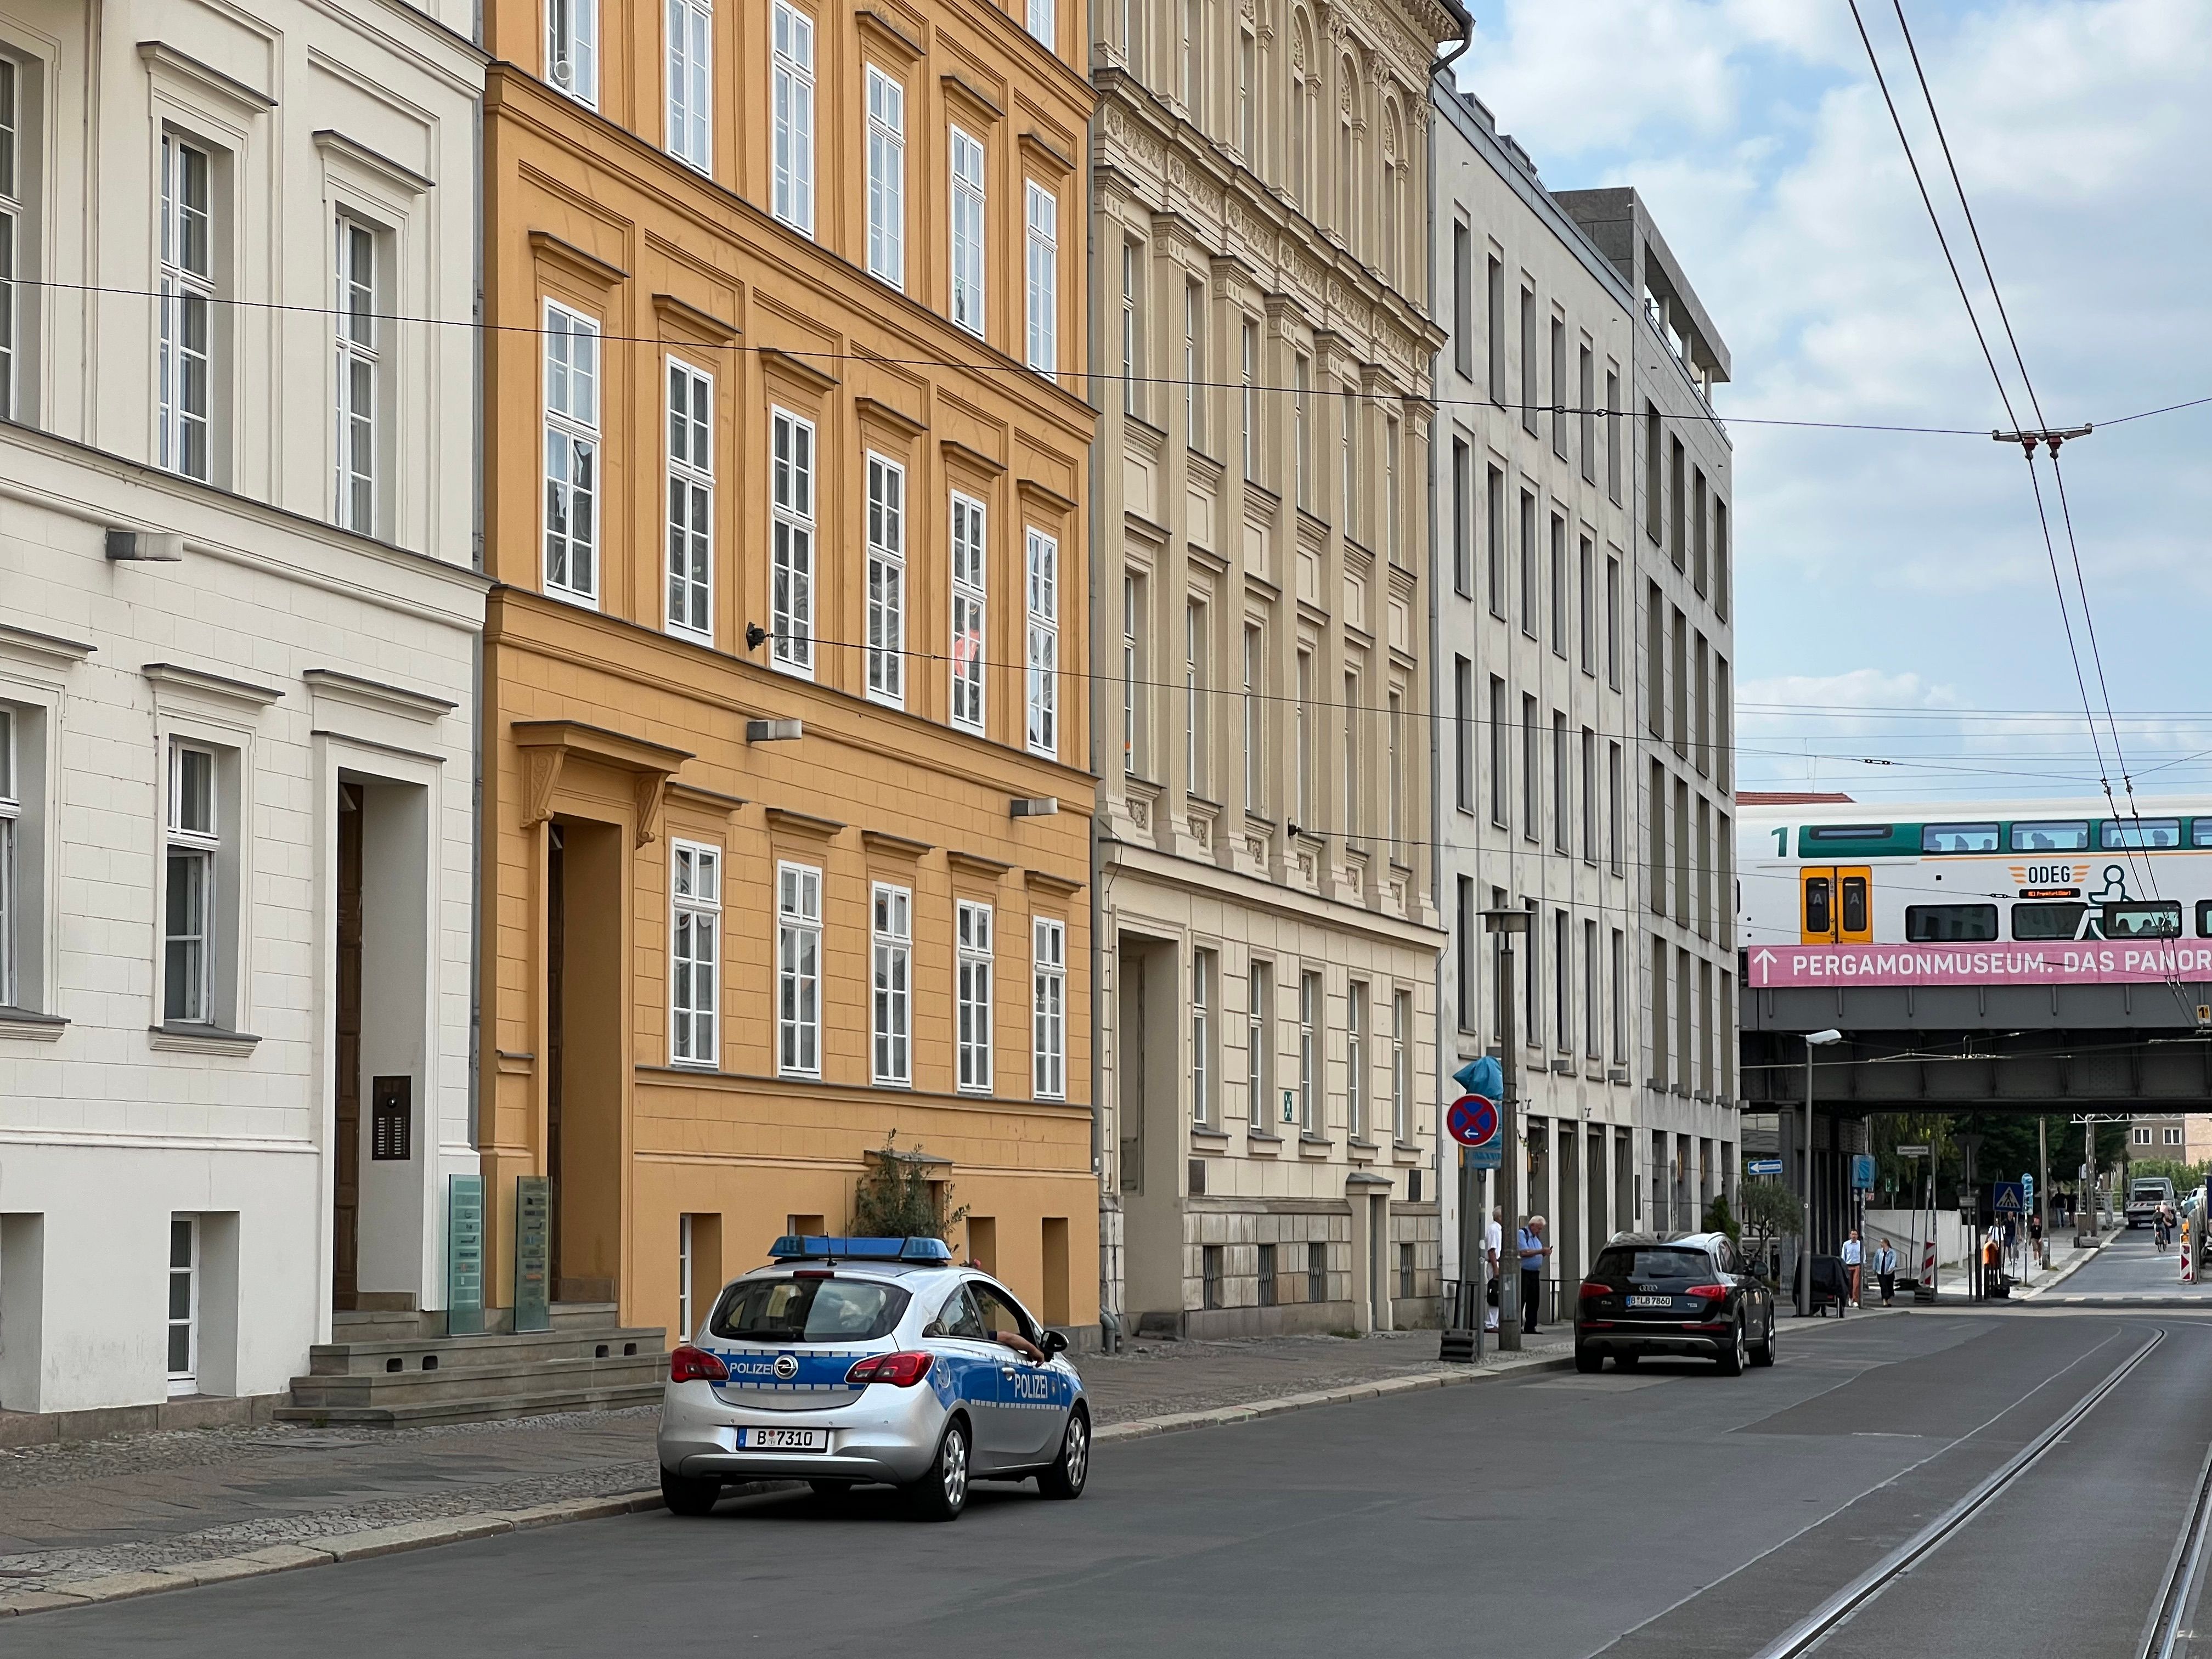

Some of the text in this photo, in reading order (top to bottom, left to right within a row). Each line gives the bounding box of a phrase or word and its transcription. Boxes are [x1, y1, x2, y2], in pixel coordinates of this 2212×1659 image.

[1771, 827, 1788, 857] 1
[2028, 865, 2070, 883] ODEG
[1792, 949, 2212, 976] PERGAMONMUSEUM. DAS PANOR
[729, 1362, 774, 1375] POLIZEI
[1014, 1373, 1048, 1399] POLIZEI
[757, 1430, 766, 1446] B
[777, 1430, 813, 1446] 7310
